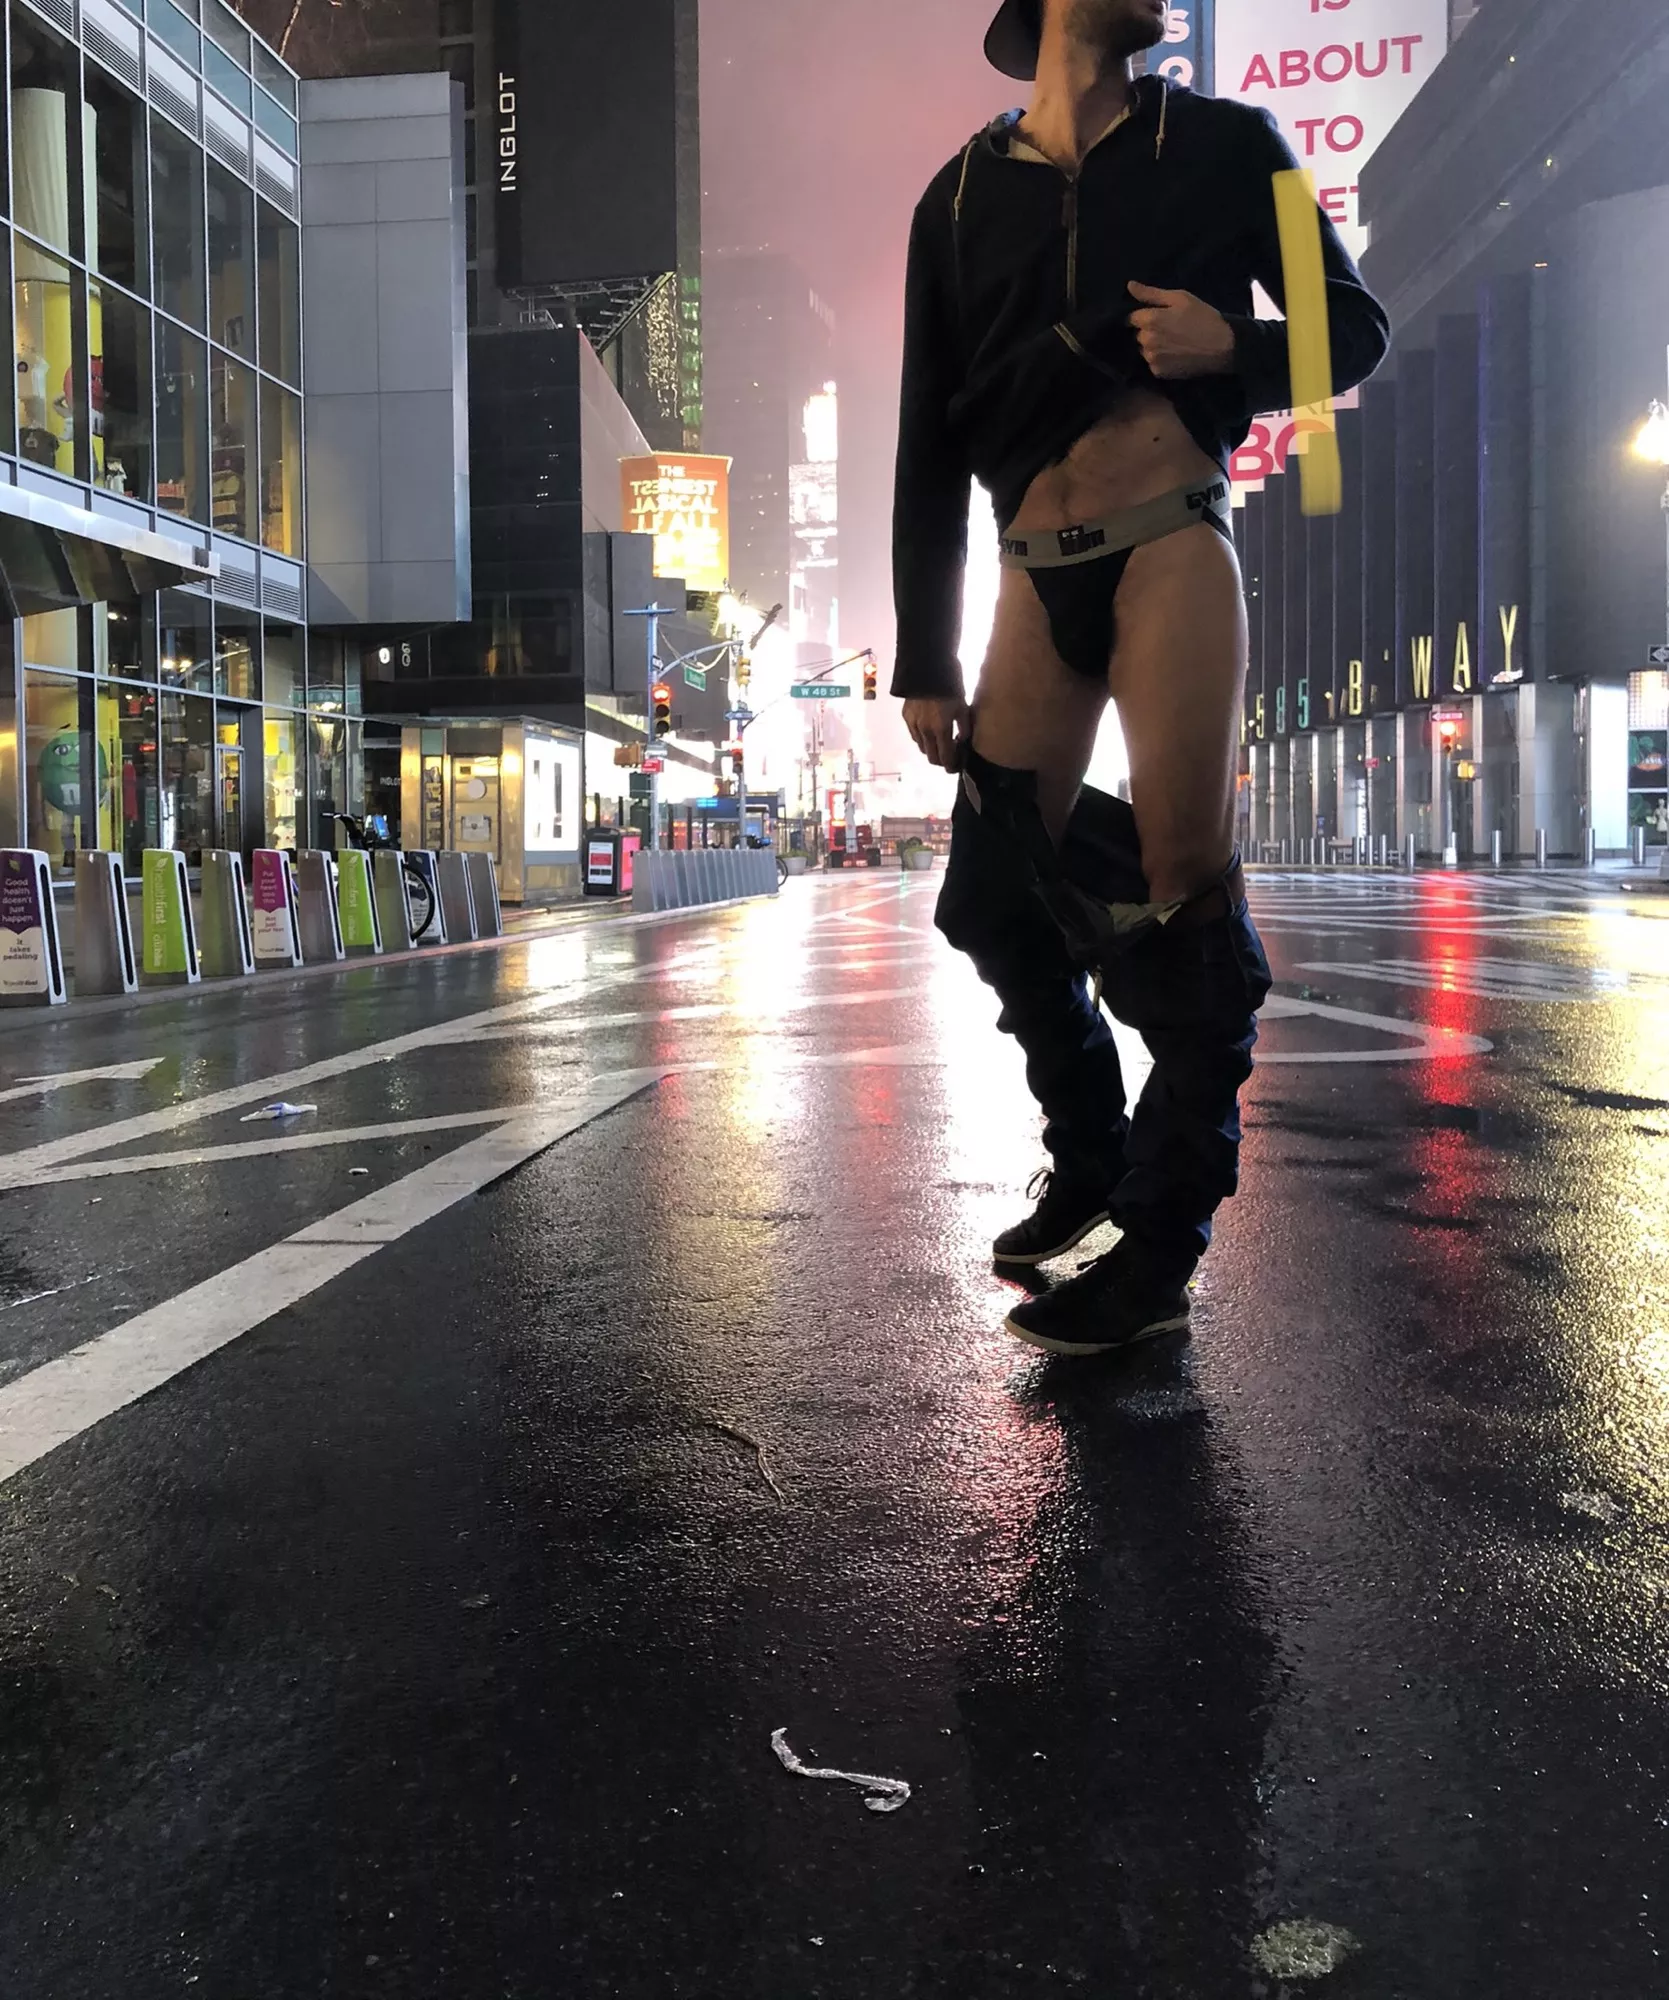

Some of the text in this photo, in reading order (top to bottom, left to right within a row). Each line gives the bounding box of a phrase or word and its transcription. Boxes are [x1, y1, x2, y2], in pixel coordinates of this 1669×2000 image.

[1239, 34, 1423, 92] ABOUT
[499, 72, 517, 192] INGLOT
[1295, 114, 1364, 156] TO
[800, 687, 811, 697] W
[829, 687, 841, 697] St
[5, 878, 28, 886] Good
[3, 887, 30, 895] health
[2, 896, 32, 904] doesn't
[9, 905, 25, 914] just
[2, 915, 33, 924] happen
[3, 953, 38, 961] pedaling
